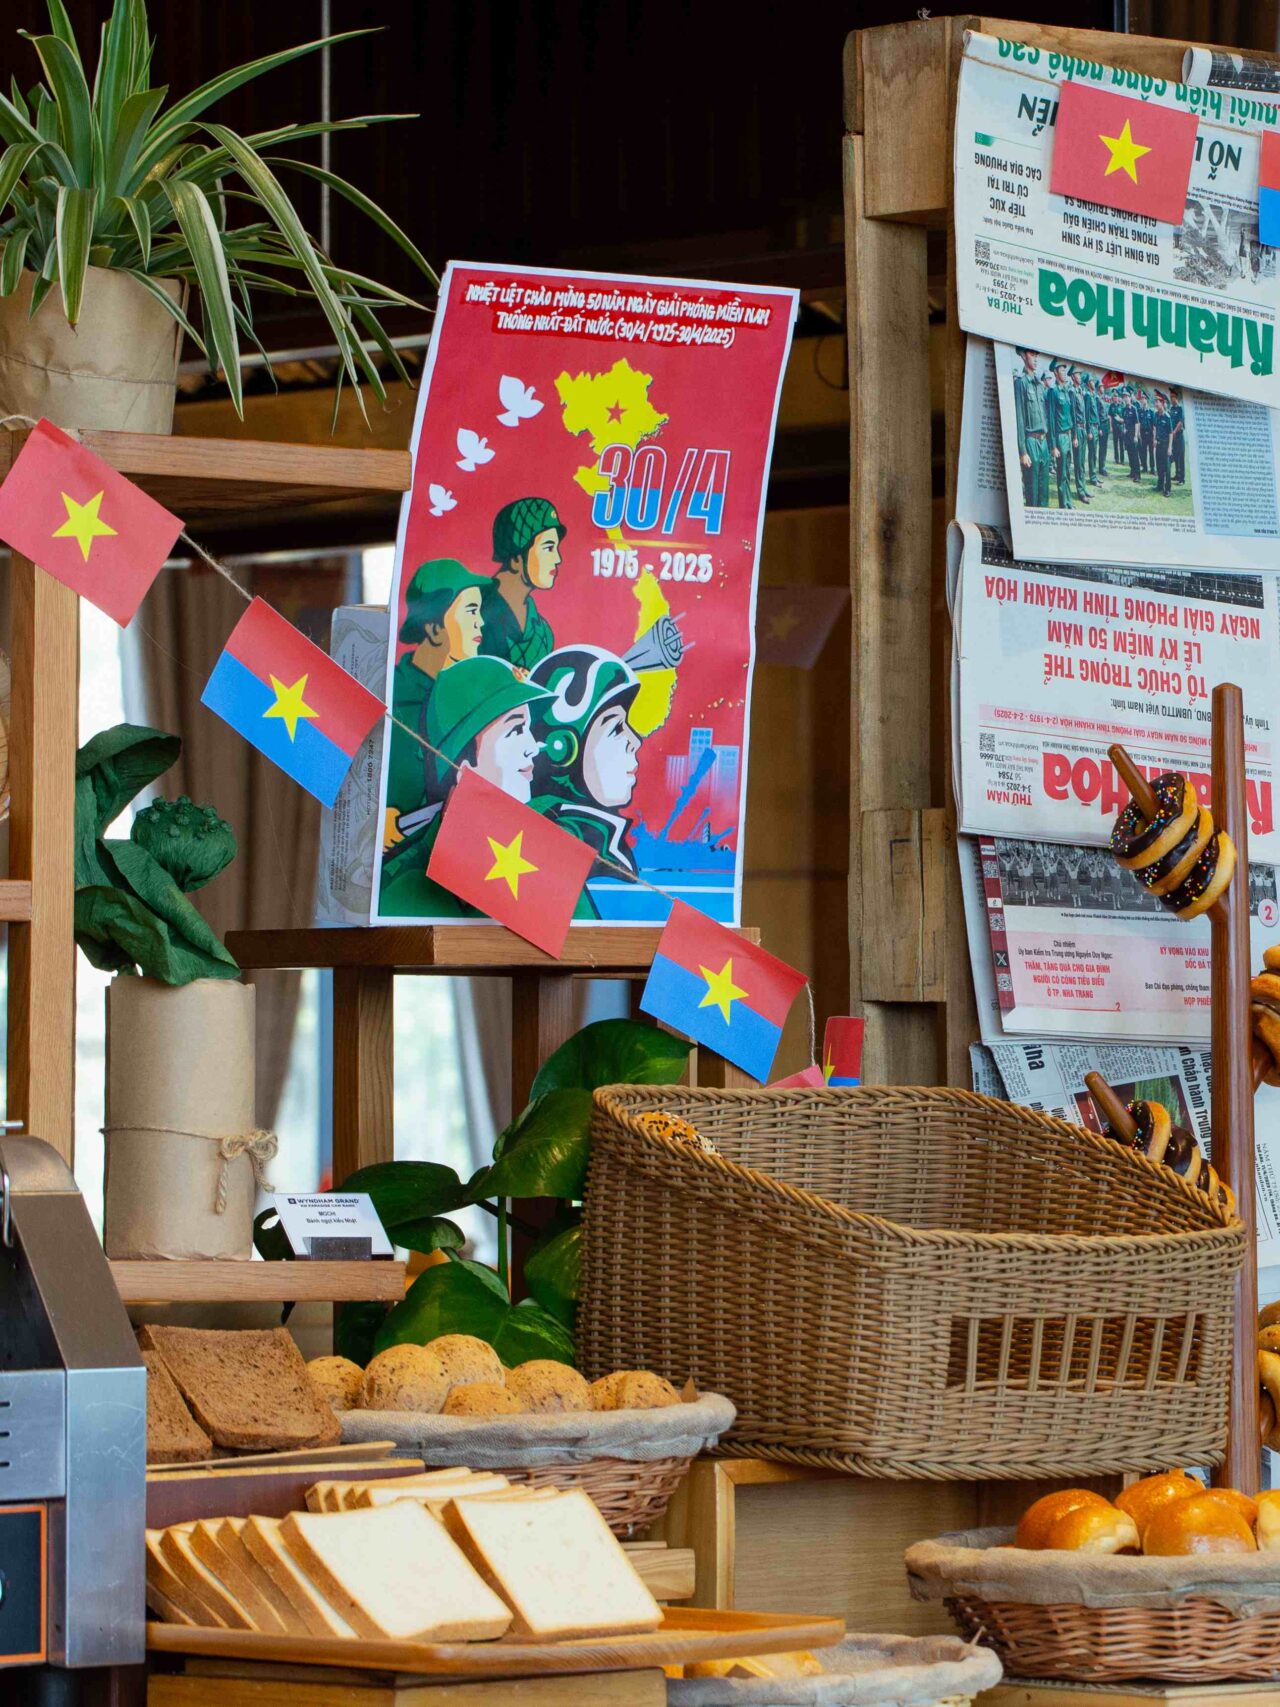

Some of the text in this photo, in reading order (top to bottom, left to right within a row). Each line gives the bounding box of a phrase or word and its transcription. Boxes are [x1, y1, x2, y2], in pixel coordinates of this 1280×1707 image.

[975, 153, 1042, 182] CÁC ĐỊA PHƯƠNG
[1210, 141, 1241, 179] NỖ
[987, 175, 1029, 198] CỬ TRI TẠI
[990, 197, 1025, 218] TIẾP XÚC
[1063, 212, 1158, 247] TRONG TRẬN CHIẾN ĐẤU
[1062, 231, 1159, 266] GIA ĐÌNH LIỆT SĨ HY SINH
[975, 259, 1000, 270] 370.6666
[993, 279, 1008, 289] 7593
[466, 282, 770, 326] NHIỆT LIỆT CHÀO MỪNG 50 NĂM NGÀY GIẢI PHÓNG MIỀN NAM
[987, 297, 1023, 315] THỨ BA
[1000, 290, 1033, 306] 15-4-2025
[1038, 268, 1127, 341] Hòa
[1132, 292, 1275, 377] Khánh
[590, 443, 731, 535] 30/4
[590, 547, 639, 578] 1975
[660, 548, 713, 583] 2025
[984, 575, 1260, 642] NGÀY GIẢI PHÓNG TỈNH KHÁNH HÒA
[1048, 620, 1202, 671] LỄ KỶ NIỆM 50 NĂM
[1043, 653, 1208, 706] TỔ CHỨC TRỌNG THỂ
[994, 709, 1024, 721] 2-4-2025)
[1029, 713, 1058, 726] (2-4-1975
[1111, 698, 1192, 720] UBMTTQ Việt Nam tỉnh:
[1060, 718, 1072, 729] HÒA
[1074, 720, 1095, 732] KHÁNH
[1096, 723, 1110, 733] TỈNH
[998, 741, 1038, 751] baokhanhhoa.vn
[1112, 726, 1207, 746] MỪNG 50 NĂM NGÀY GIẢI PHÓNG
[980, 752, 1005, 761] 370.6666
[998, 771, 1021, 781] Số 7584
[1042, 752, 1134, 816] Hòa
[987, 789, 1032, 806] THỨ NĂM
[1007, 783, 1032, 793] 3-4-2025
[1160, 946, 1209, 956] KỲ VỌNG VÀO KHU
[1180, 1058, 1211, 1139] Chấp hành Trung
